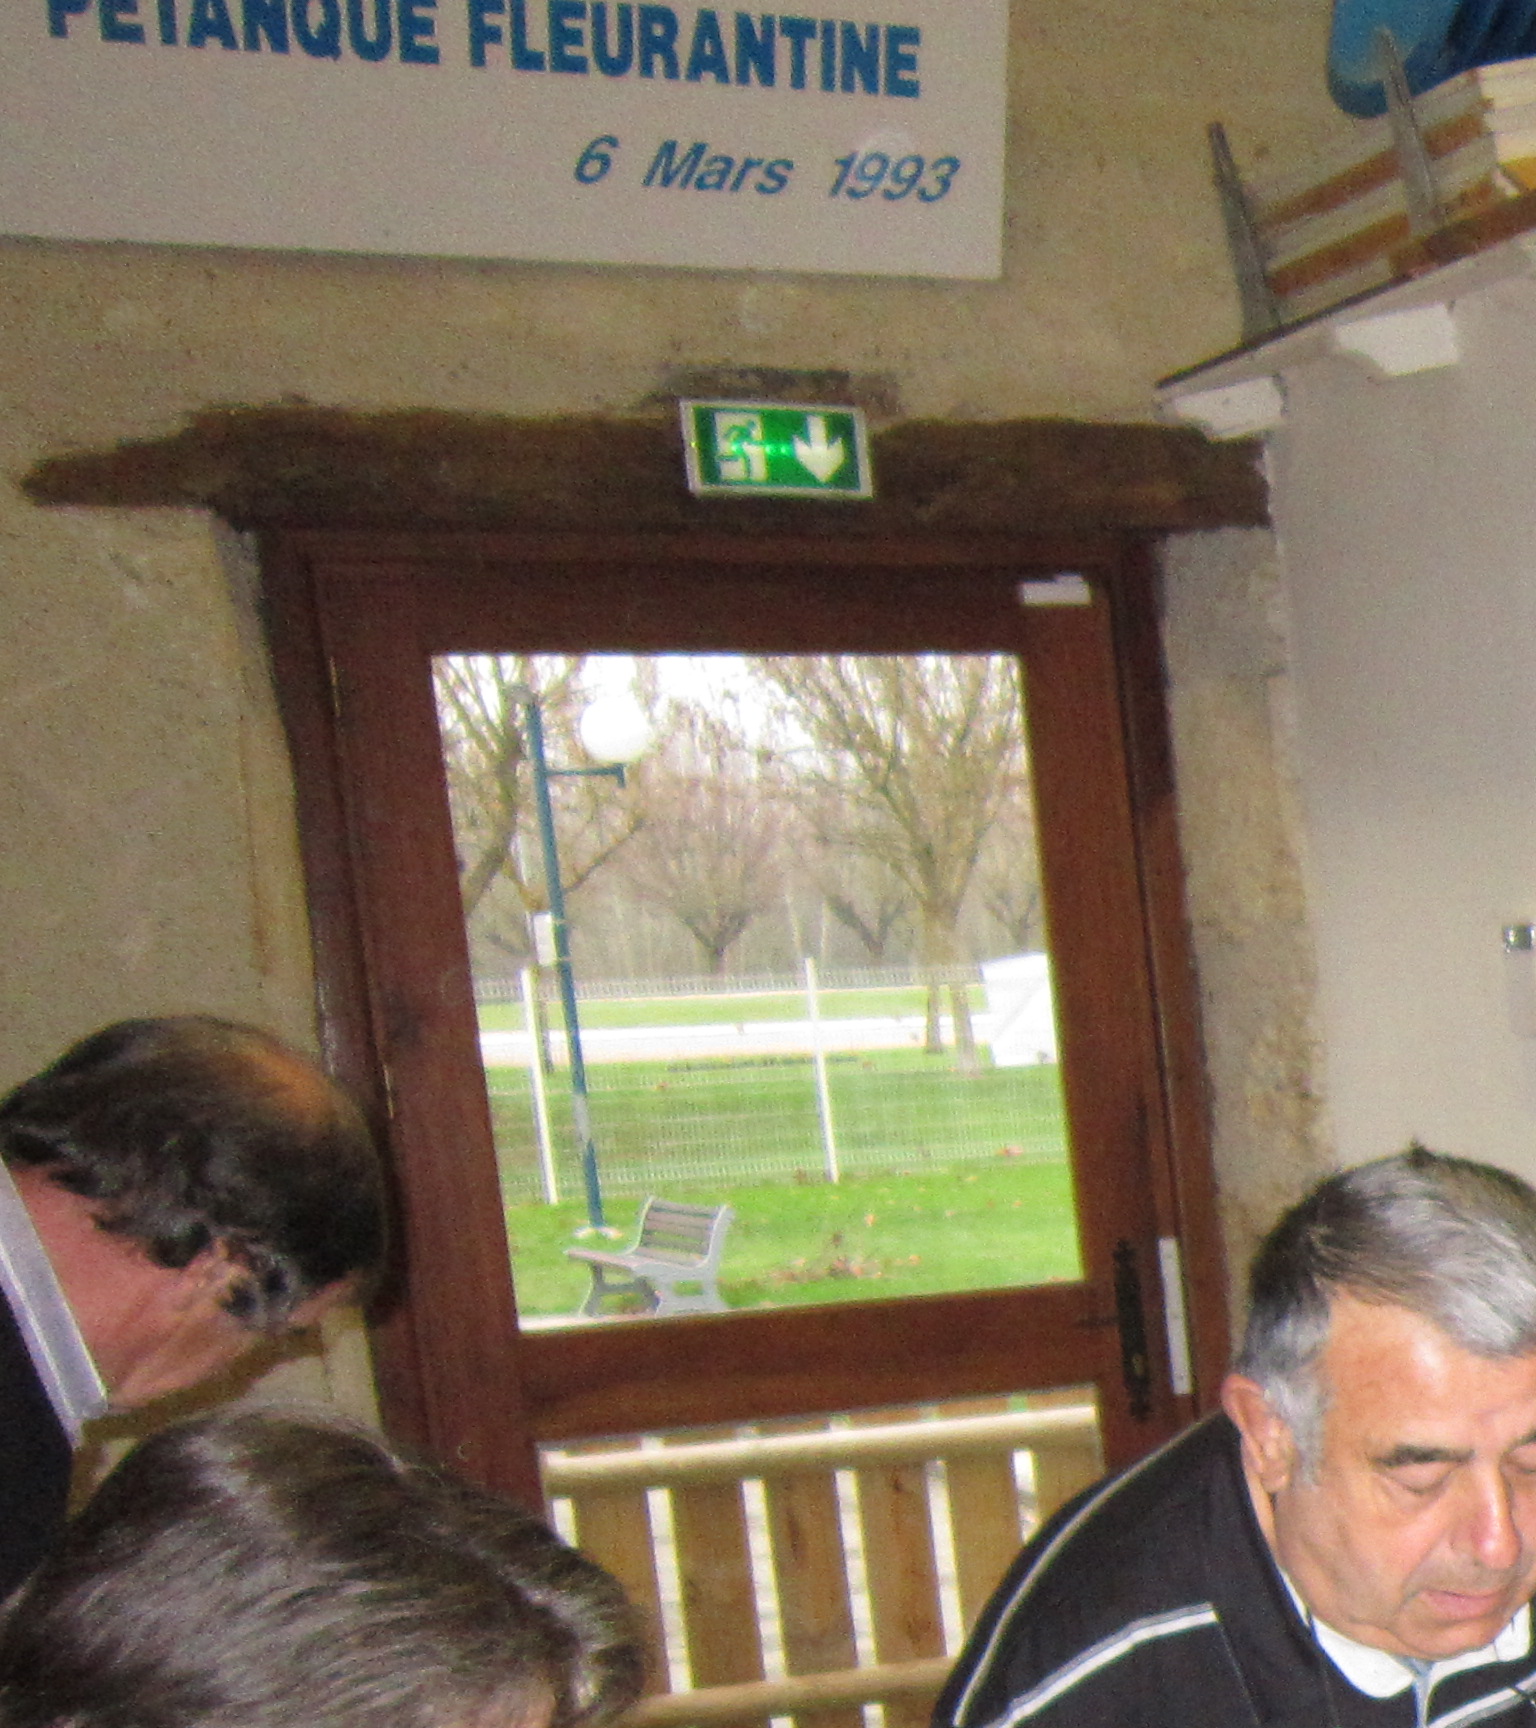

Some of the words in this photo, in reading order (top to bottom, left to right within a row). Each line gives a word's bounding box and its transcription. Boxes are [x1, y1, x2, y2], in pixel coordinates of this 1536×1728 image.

[467, 0, 922, 98] FLEURANTINE
[574, 134, 619, 187] 6
[641, 138, 794, 196] Mars
[828, 150, 961, 203] 1993
